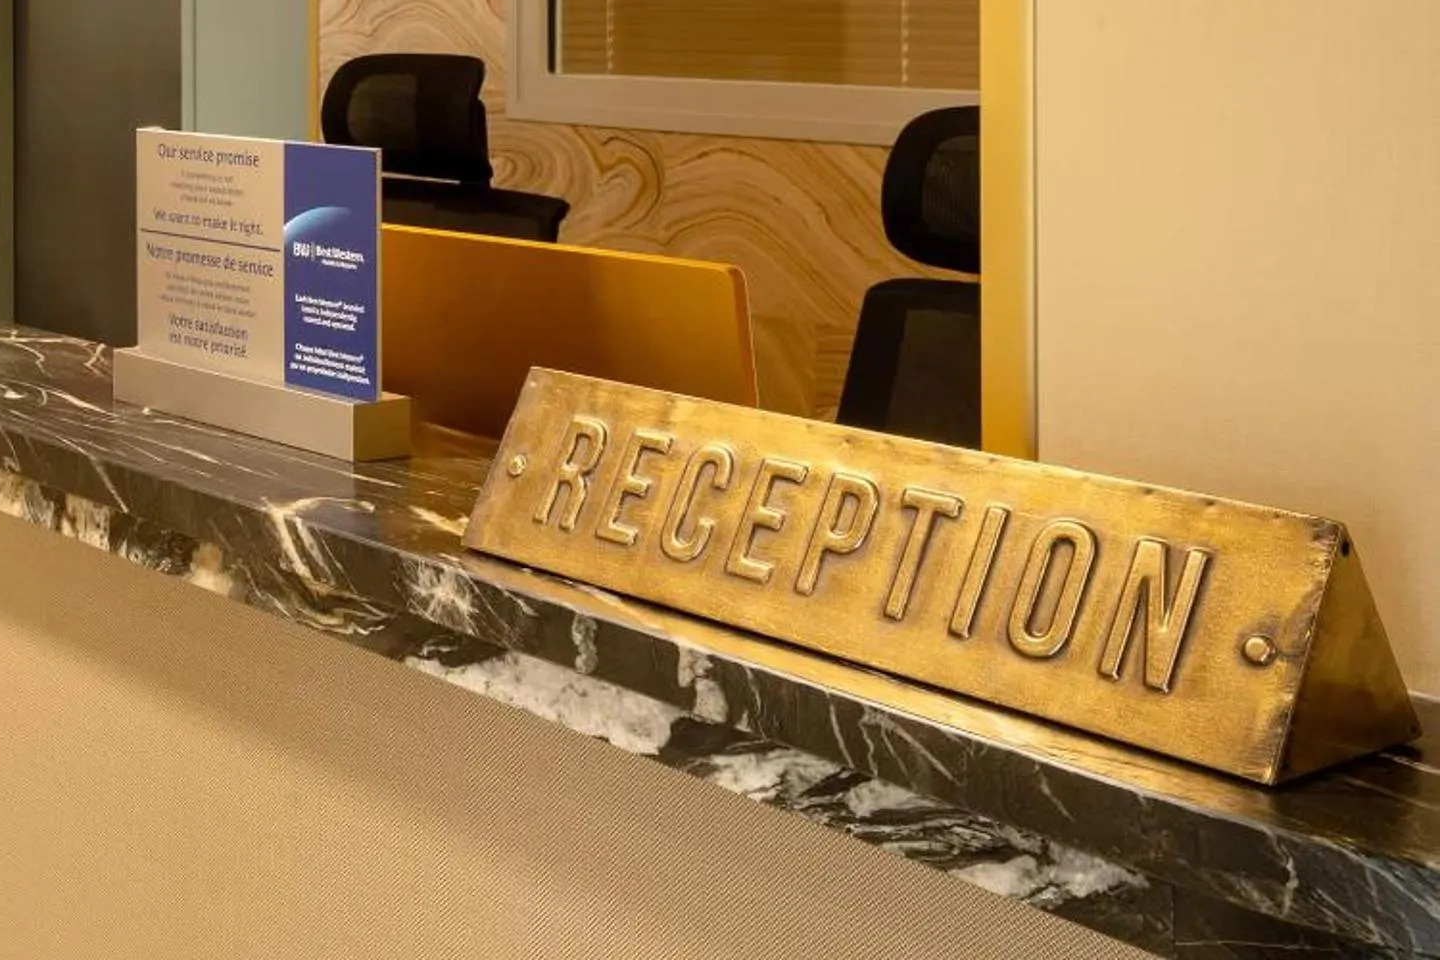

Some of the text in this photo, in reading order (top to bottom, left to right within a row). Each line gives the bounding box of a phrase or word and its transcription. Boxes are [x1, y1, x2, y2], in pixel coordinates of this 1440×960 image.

[158, 143, 260, 167] Our service promise
[223, 254, 236, 271] de
[238, 259, 274, 277] service
[534, 414, 1214, 695] RECEPTION
